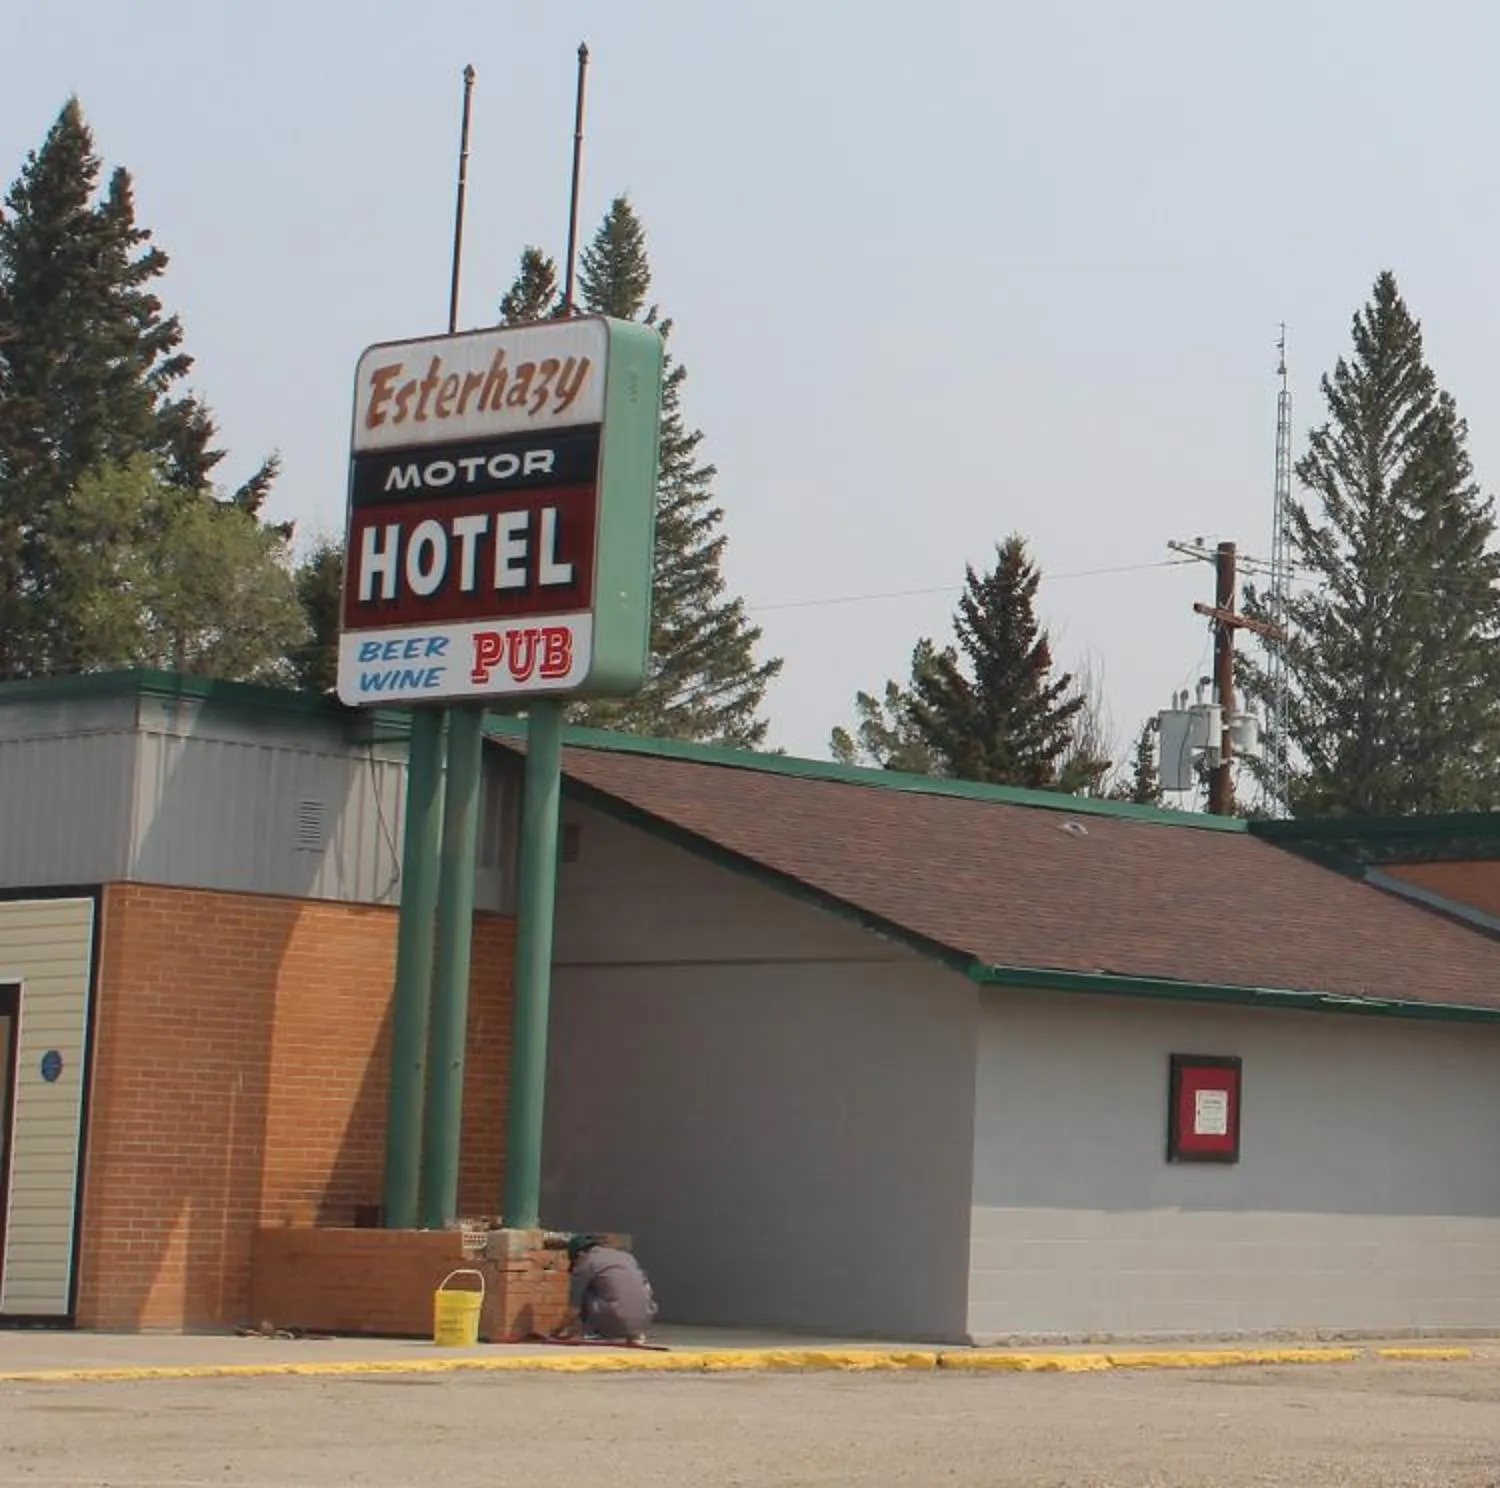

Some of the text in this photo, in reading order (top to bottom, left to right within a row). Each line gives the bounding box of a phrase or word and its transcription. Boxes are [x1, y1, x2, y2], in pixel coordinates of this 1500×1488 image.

[367, 349, 591, 430] Esterhazy
[385, 449, 555, 490] MOTOR
[359, 507, 573, 601] HOTEL
[358, 636, 451, 663] BEER
[471, 626, 574, 684] PUB
[359, 667, 446, 693] WINE
